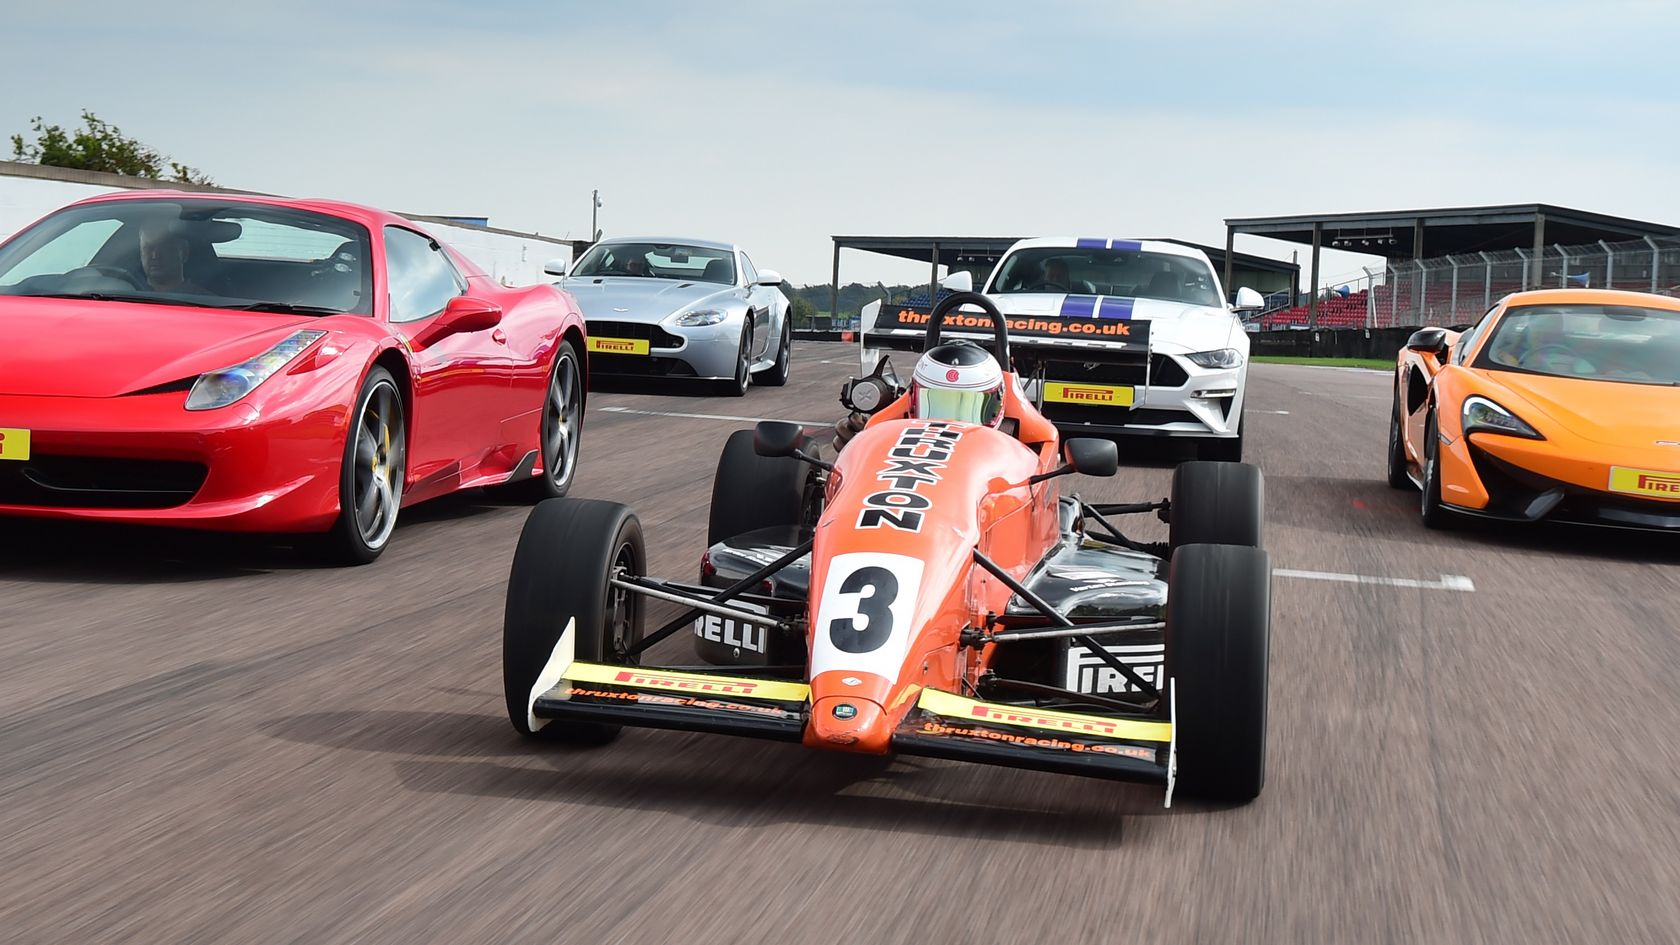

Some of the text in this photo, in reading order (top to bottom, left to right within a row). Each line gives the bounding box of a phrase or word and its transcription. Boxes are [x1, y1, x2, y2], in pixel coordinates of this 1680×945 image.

[898, 310, 1130, 336] thrxtonacing.co.uk
[596, 340, 634, 351] PIRELLI
[1063, 387, 1114, 401] PIRELLI
[829, 566, 899, 654] 3
[614, 671, 757, 694] PIRELLI
[564, 687, 784, 715] thruxtonracing.co.uk
[971, 705, 1117, 734] PIRELLI
[924, 722, 1151, 757] thruxtonracing.co.uk
